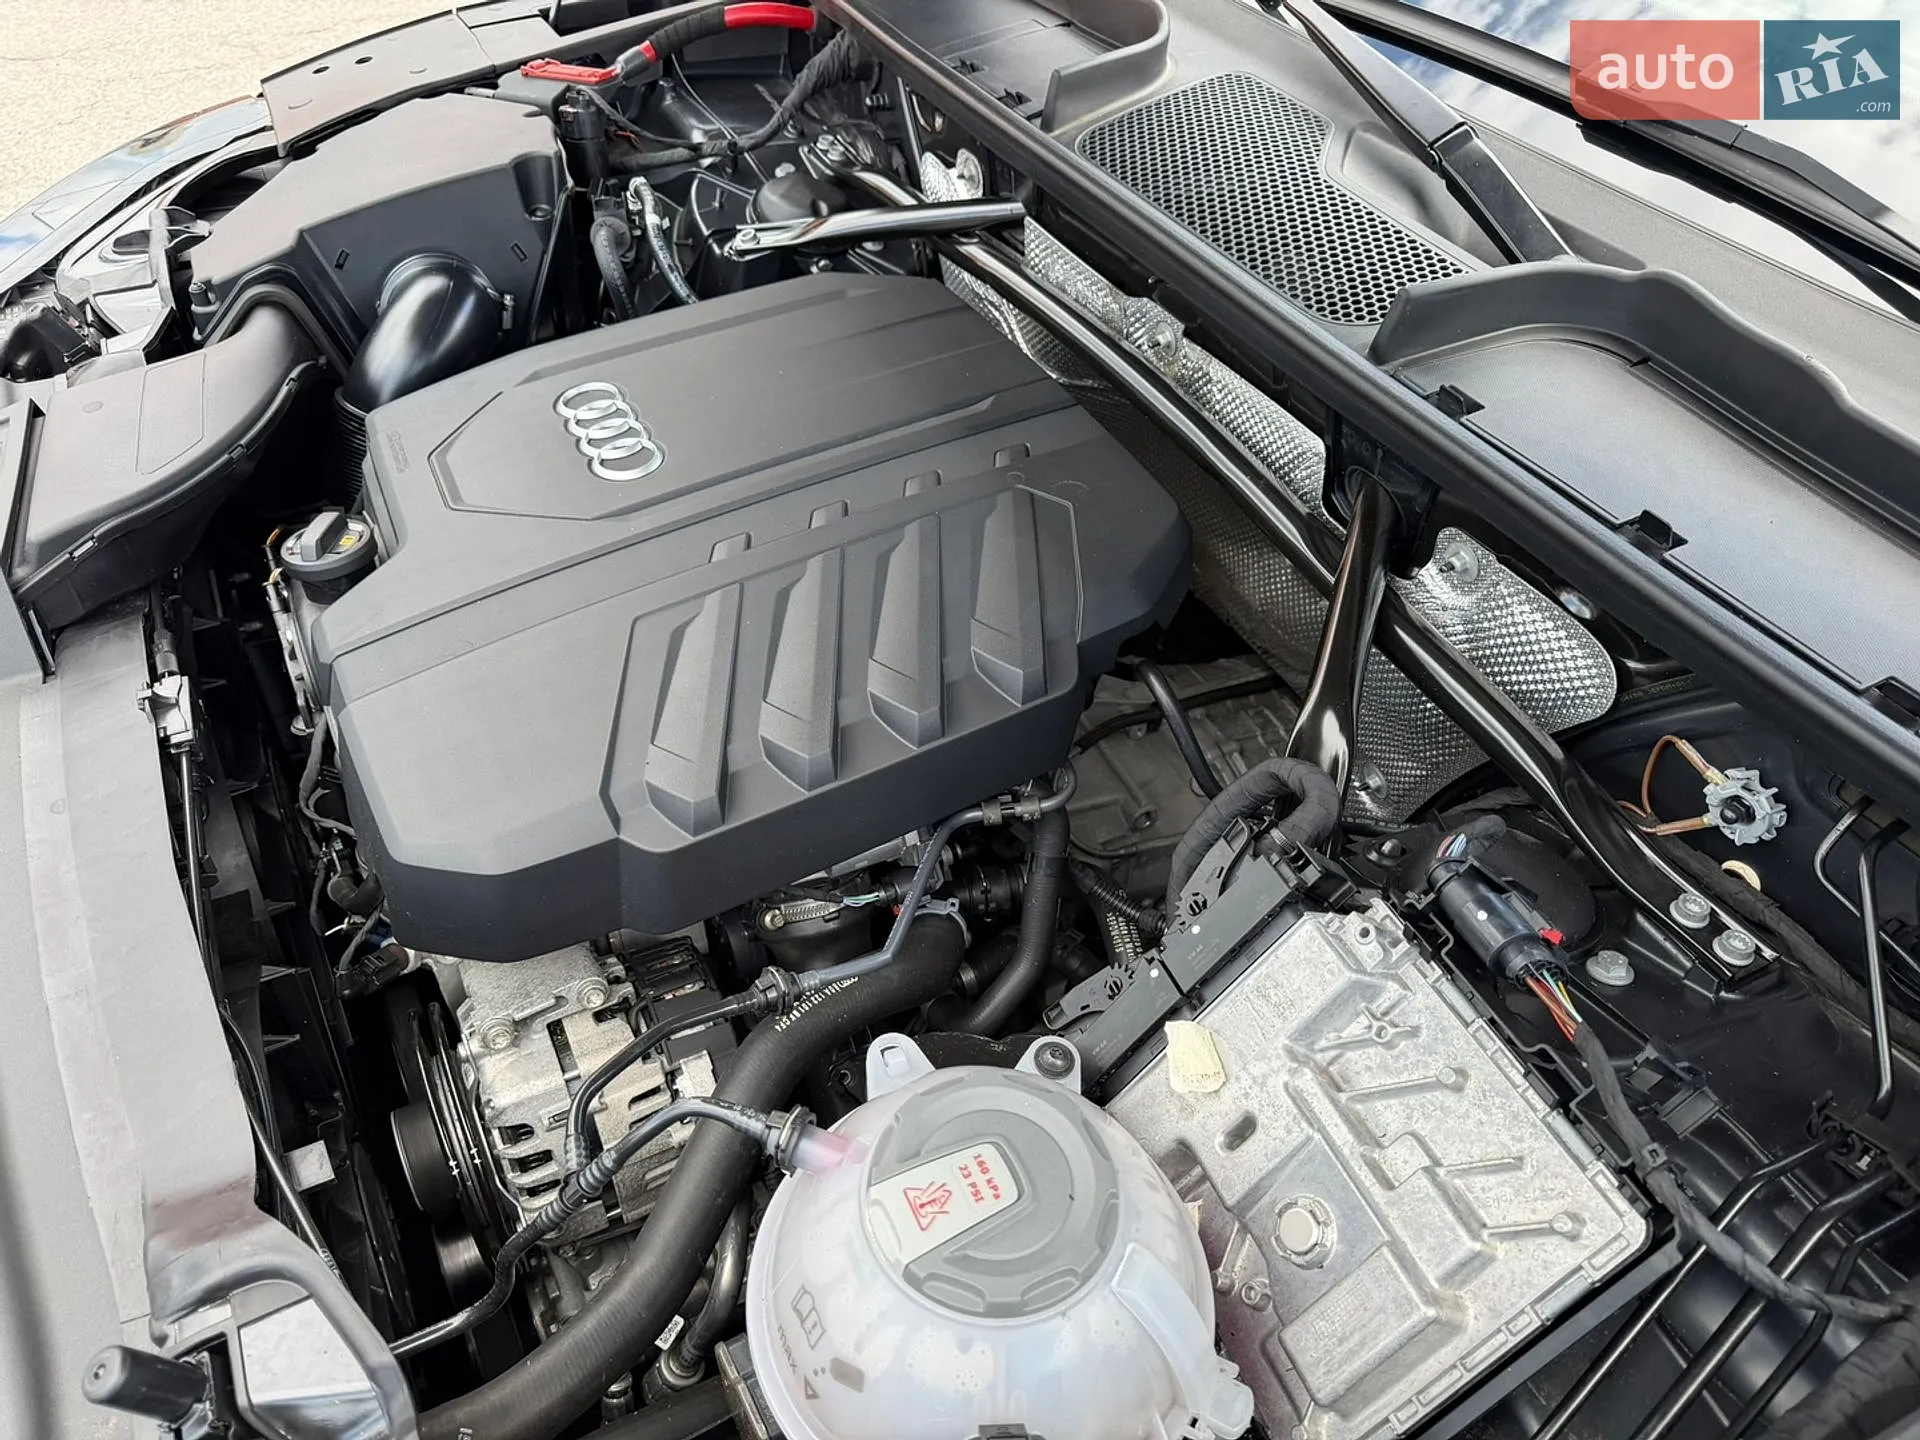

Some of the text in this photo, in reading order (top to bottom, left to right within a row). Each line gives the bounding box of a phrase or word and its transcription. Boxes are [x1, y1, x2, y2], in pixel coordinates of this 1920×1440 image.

[958, 1164, 986, 1204] 23 PSI
[973, 1153, 990, 1175] 160
[778, 1325, 797, 1375] max
